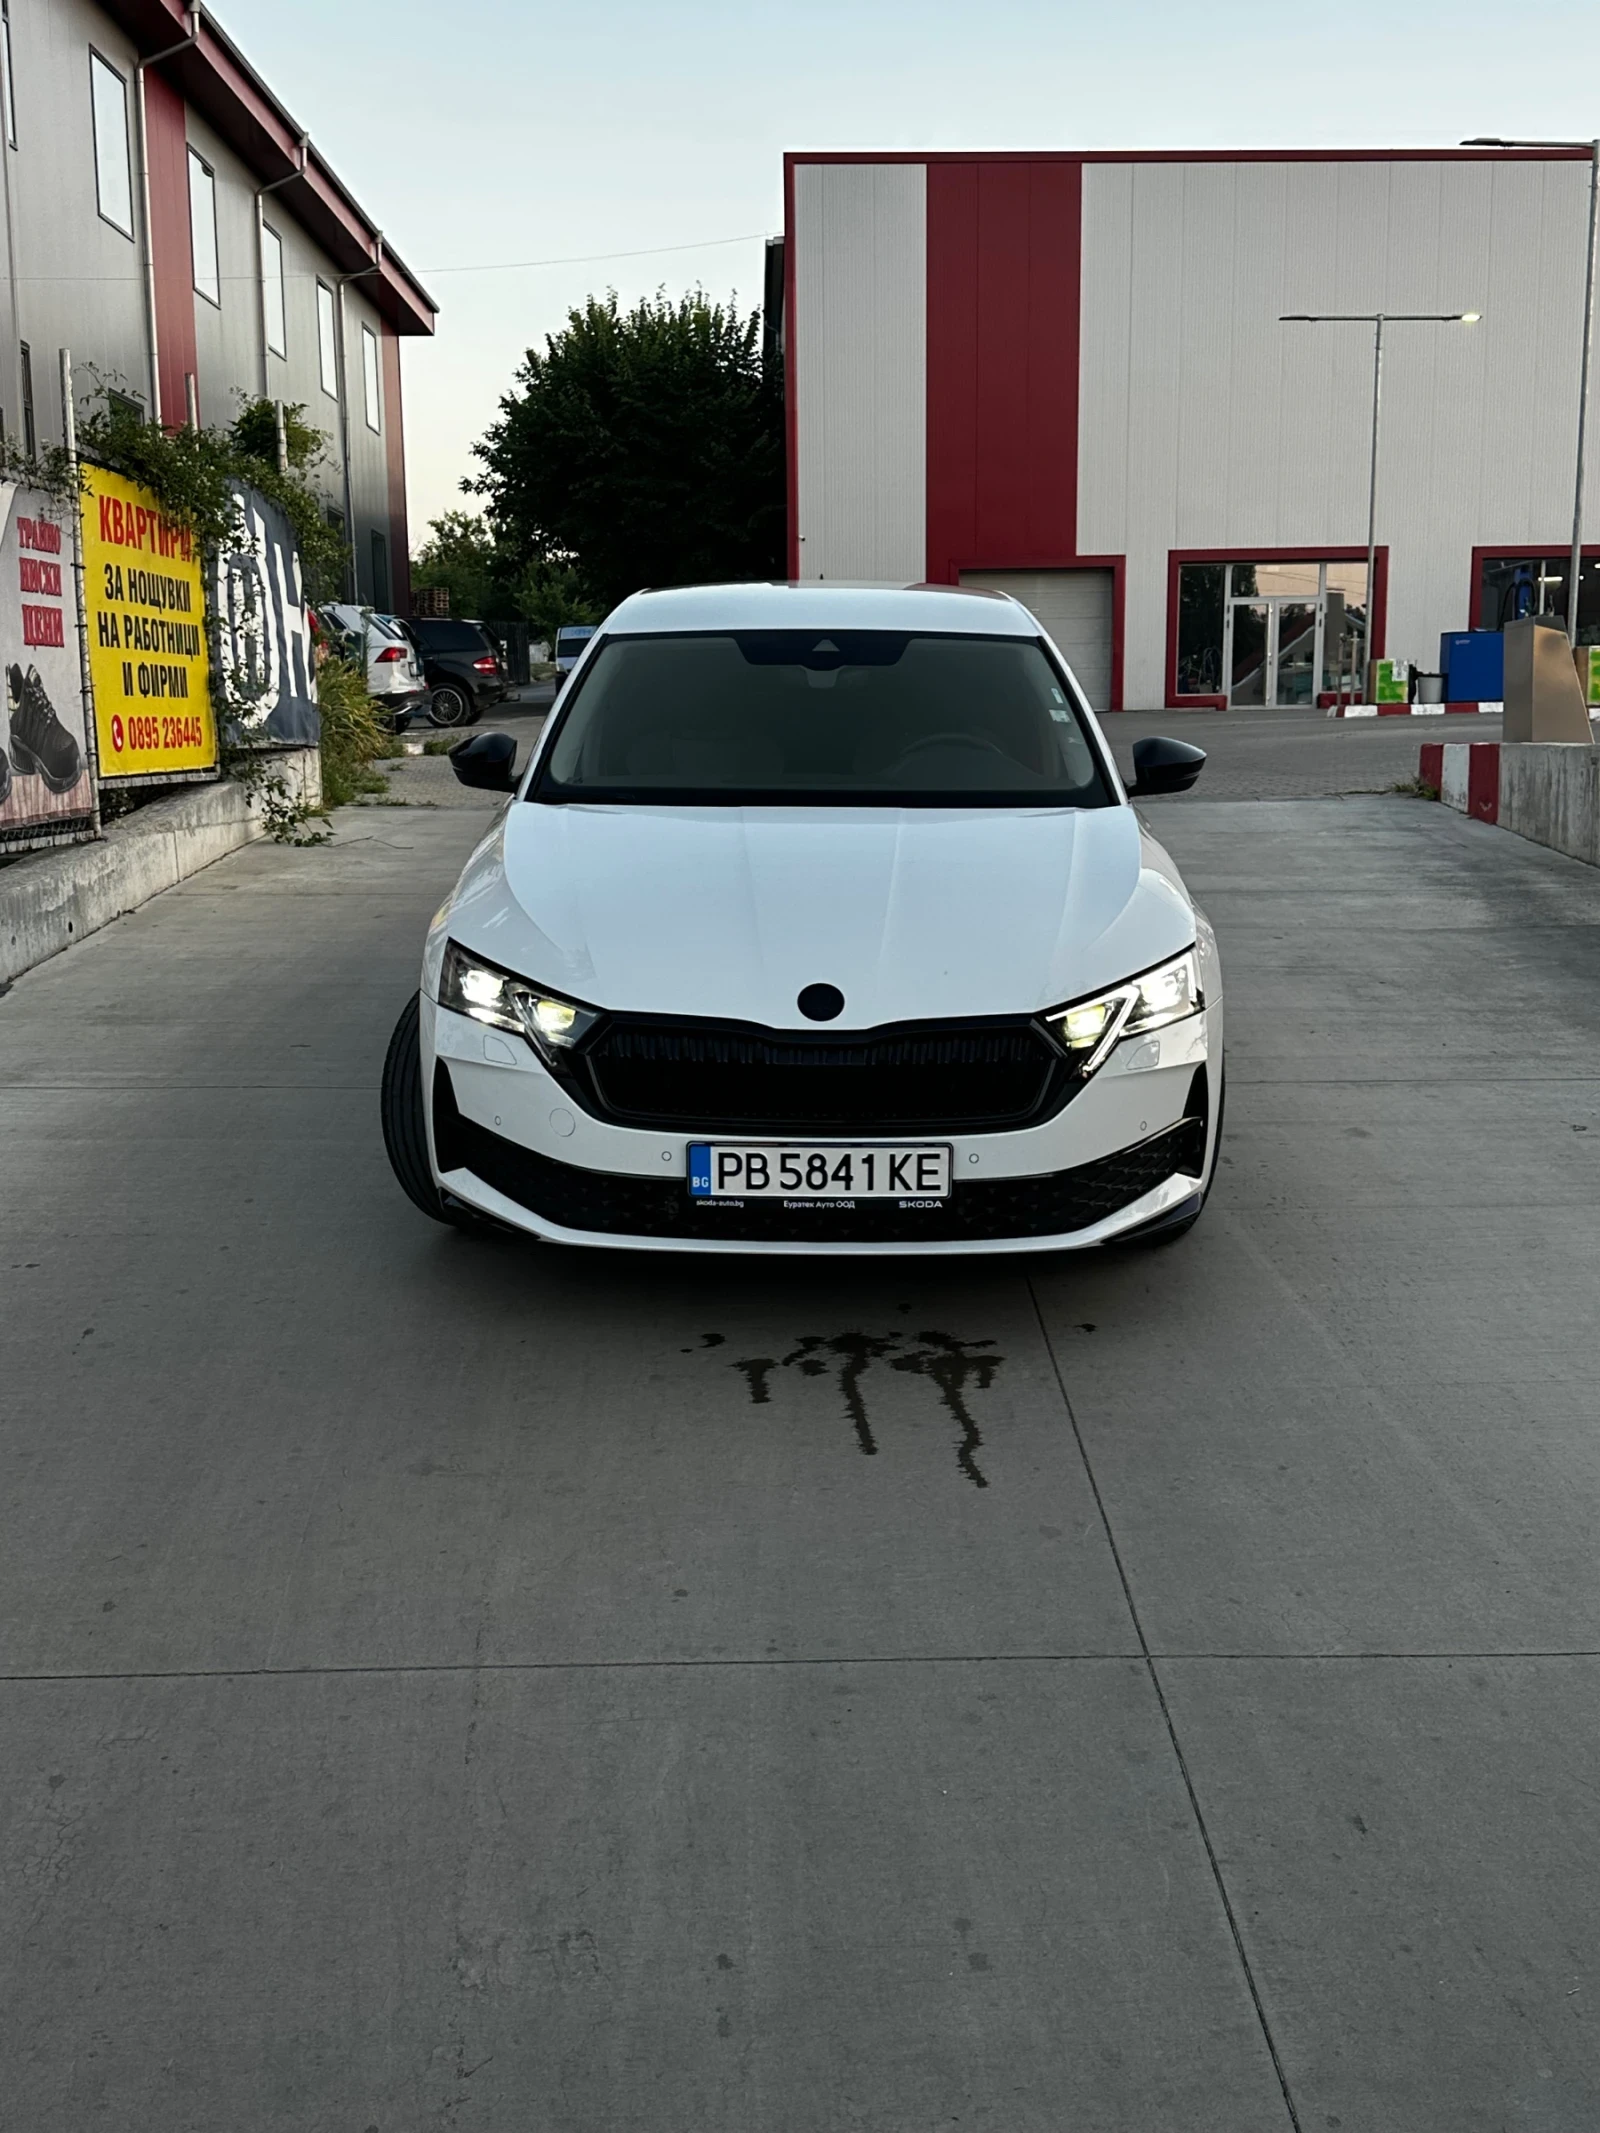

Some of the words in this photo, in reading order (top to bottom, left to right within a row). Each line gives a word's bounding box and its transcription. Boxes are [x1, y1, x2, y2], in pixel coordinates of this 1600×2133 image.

[19, 557, 63, 597] НИСКИ
[104, 563, 125, 602] ЗА
[127, 567, 191, 614] НОЩУВКИ
[21, 604, 65, 651] ЦЕНИ
[97, 611, 121, 649] НА
[123, 614, 201, 662] РАБОТНИЦИ
[122, 661, 134, 696] И
[137, 662, 189, 698] ФИРМИ
[128, 716, 160, 750] 0895
[162, 716, 203, 749] 236445
[692, 1177, 709, 1188] BG
[717, 1152, 770, 1190] PB
[779, 1153, 875, 1191] 5841
[889, 1153, 942, 1191] KE
[783, 1200, 815, 1209] Еуратек
[815, 1201, 835, 1209] Ауто
[836, 1200, 856, 1209] ООД
